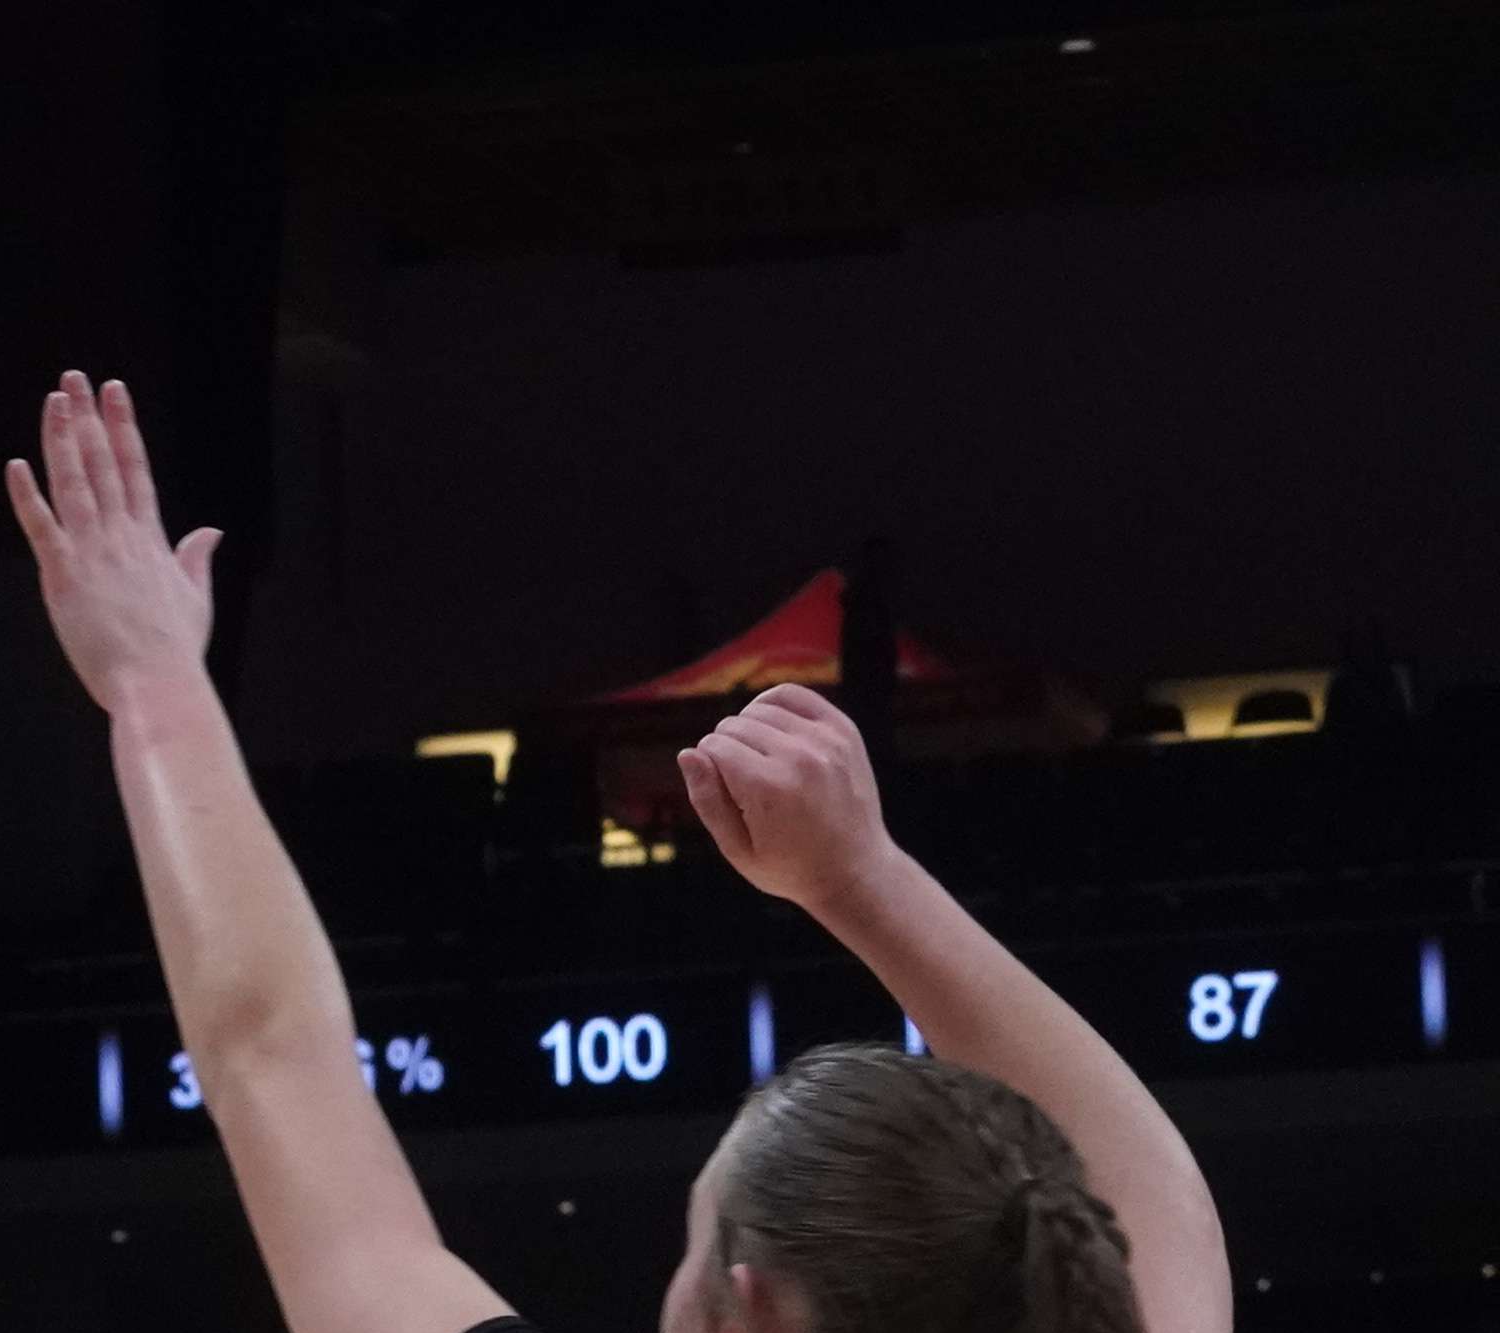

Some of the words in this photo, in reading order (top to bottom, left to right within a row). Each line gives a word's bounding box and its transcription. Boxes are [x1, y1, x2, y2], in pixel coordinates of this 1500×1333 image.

[1188, 970, 1278, 1042] 87
[385, 1033, 445, 1095] %
[539, 1013, 668, 1087] 100
